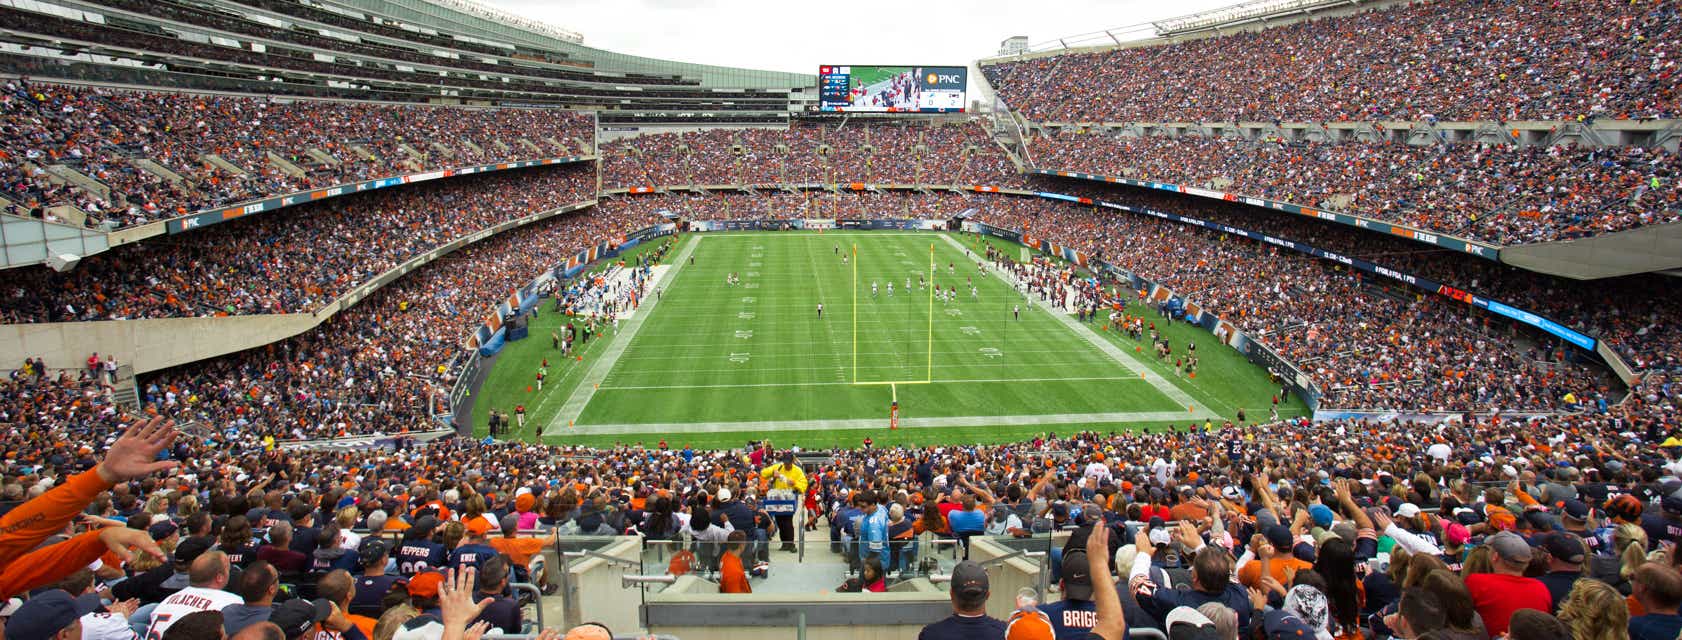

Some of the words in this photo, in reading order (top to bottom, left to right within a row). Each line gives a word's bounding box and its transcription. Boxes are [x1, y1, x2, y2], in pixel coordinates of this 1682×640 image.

[938, 74, 960, 84] PNC
[401, 545, 430, 558] PEPPERS
[460, 552, 476, 563] KNOX
